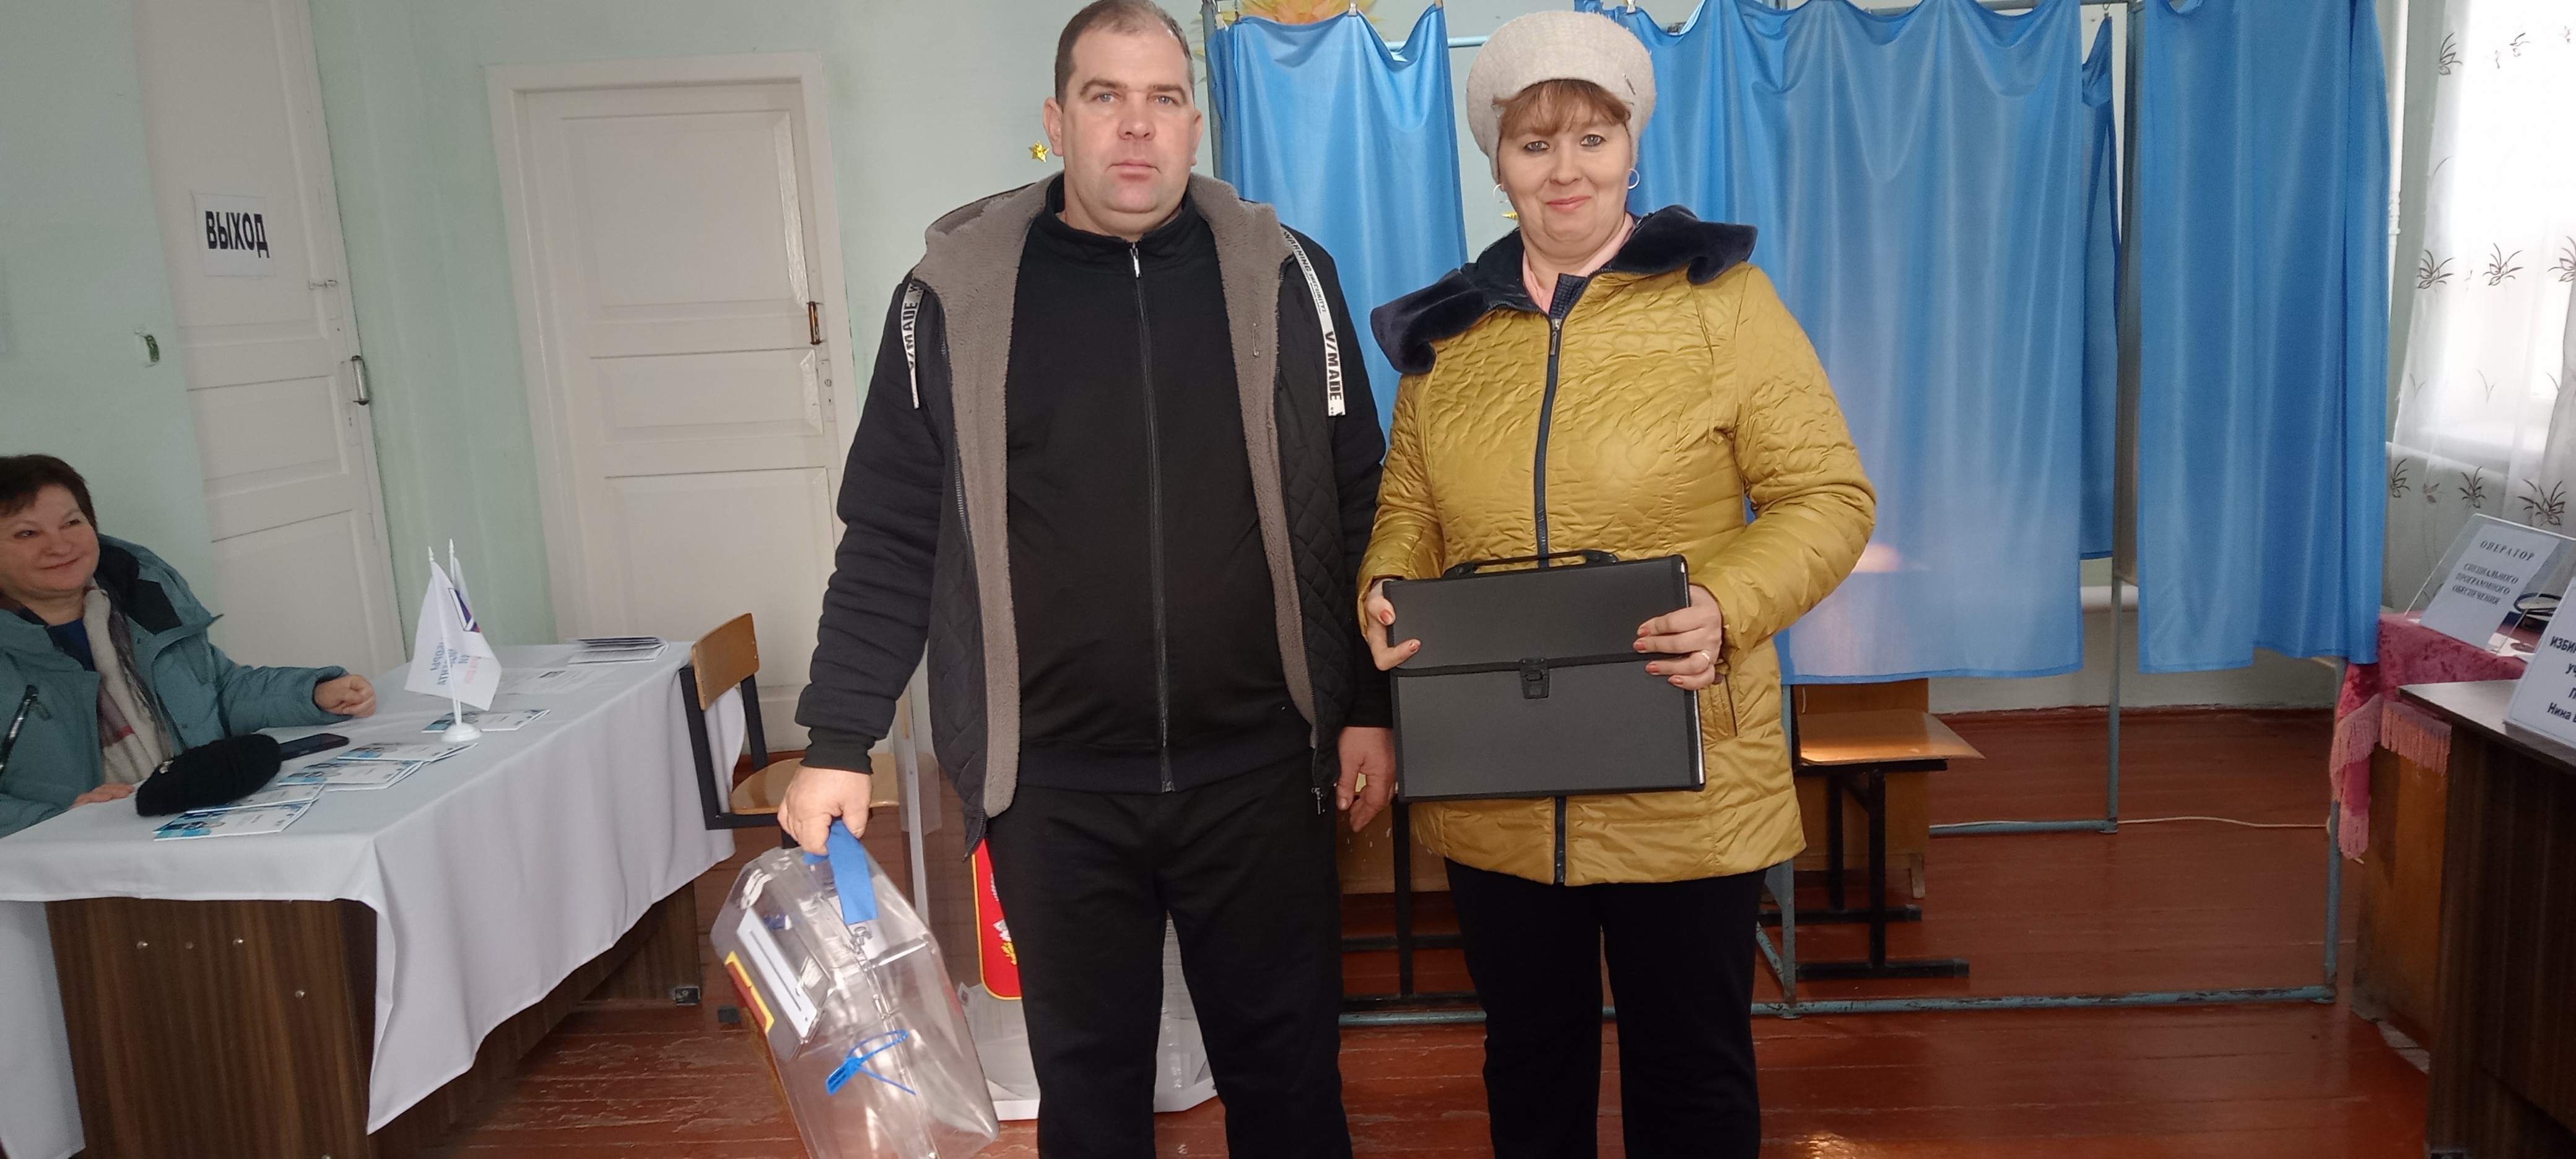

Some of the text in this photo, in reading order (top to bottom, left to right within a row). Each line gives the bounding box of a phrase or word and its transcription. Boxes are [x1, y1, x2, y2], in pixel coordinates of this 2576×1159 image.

[205, 210, 270, 258] ВЫХОД
[1325, 331, 1342, 401] V/MADE
[2479, 540, 2535, 561] ОПЕРАТОР
[2547, 701, 2572, 721] Нина
